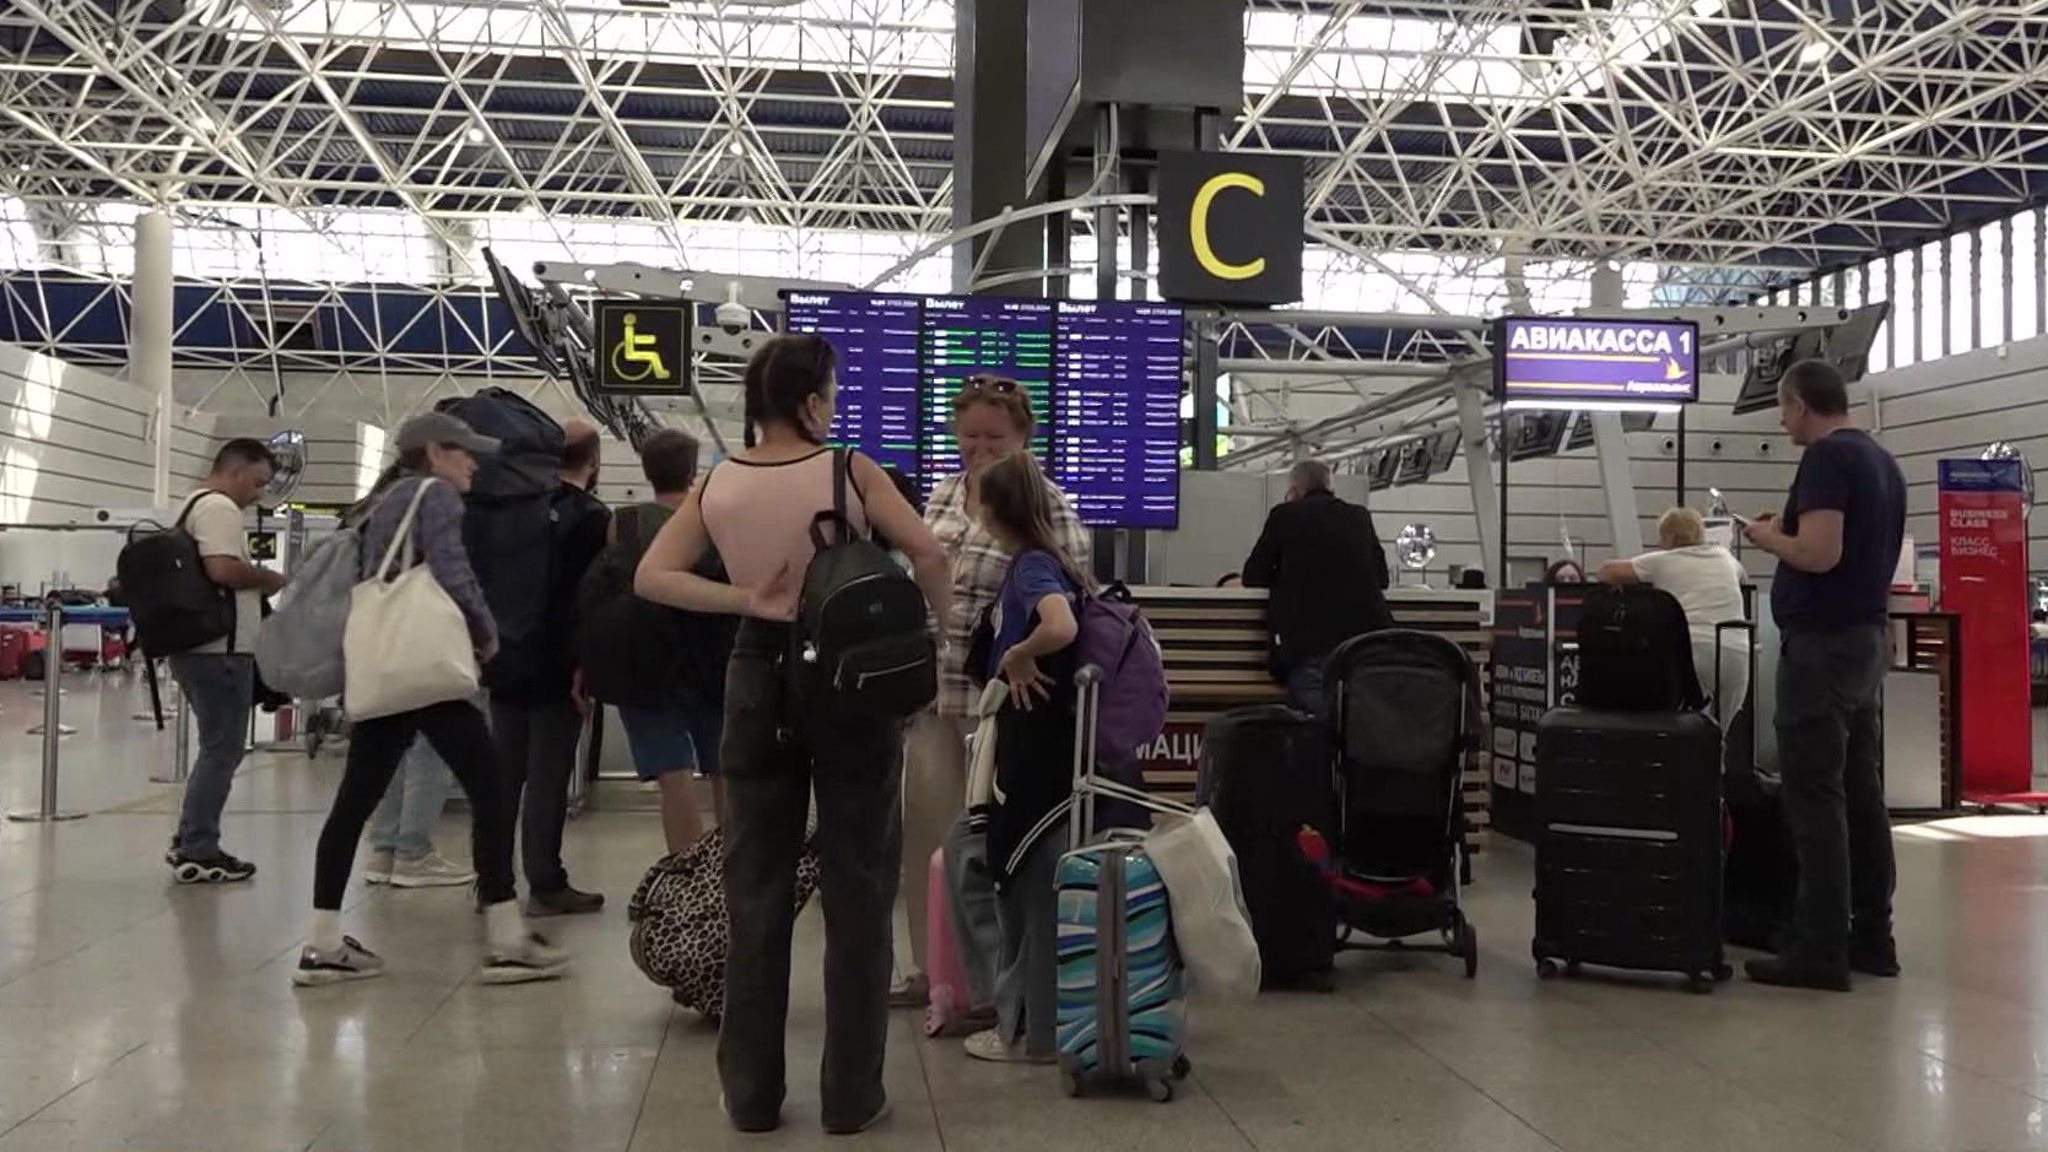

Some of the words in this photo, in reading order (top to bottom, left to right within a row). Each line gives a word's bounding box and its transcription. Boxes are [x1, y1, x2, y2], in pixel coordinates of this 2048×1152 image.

[1190, 172, 1265, 280] C
[790, 293, 830, 305] Вылет
[925, 298, 964, 310] Вылет
[1058, 302, 1097, 313] Вылет
[1510, 326, 1672, 353] АВИАКАССА
[1679, 331, 1690, 354] 1
[1950, 509, 2008, 519] BUSINESS
[1950, 519, 1988, 528] CLASS
[1950, 536, 1989, 546] КЛАСС
[1951, 545, 1998, 556] БИЗНЕС
